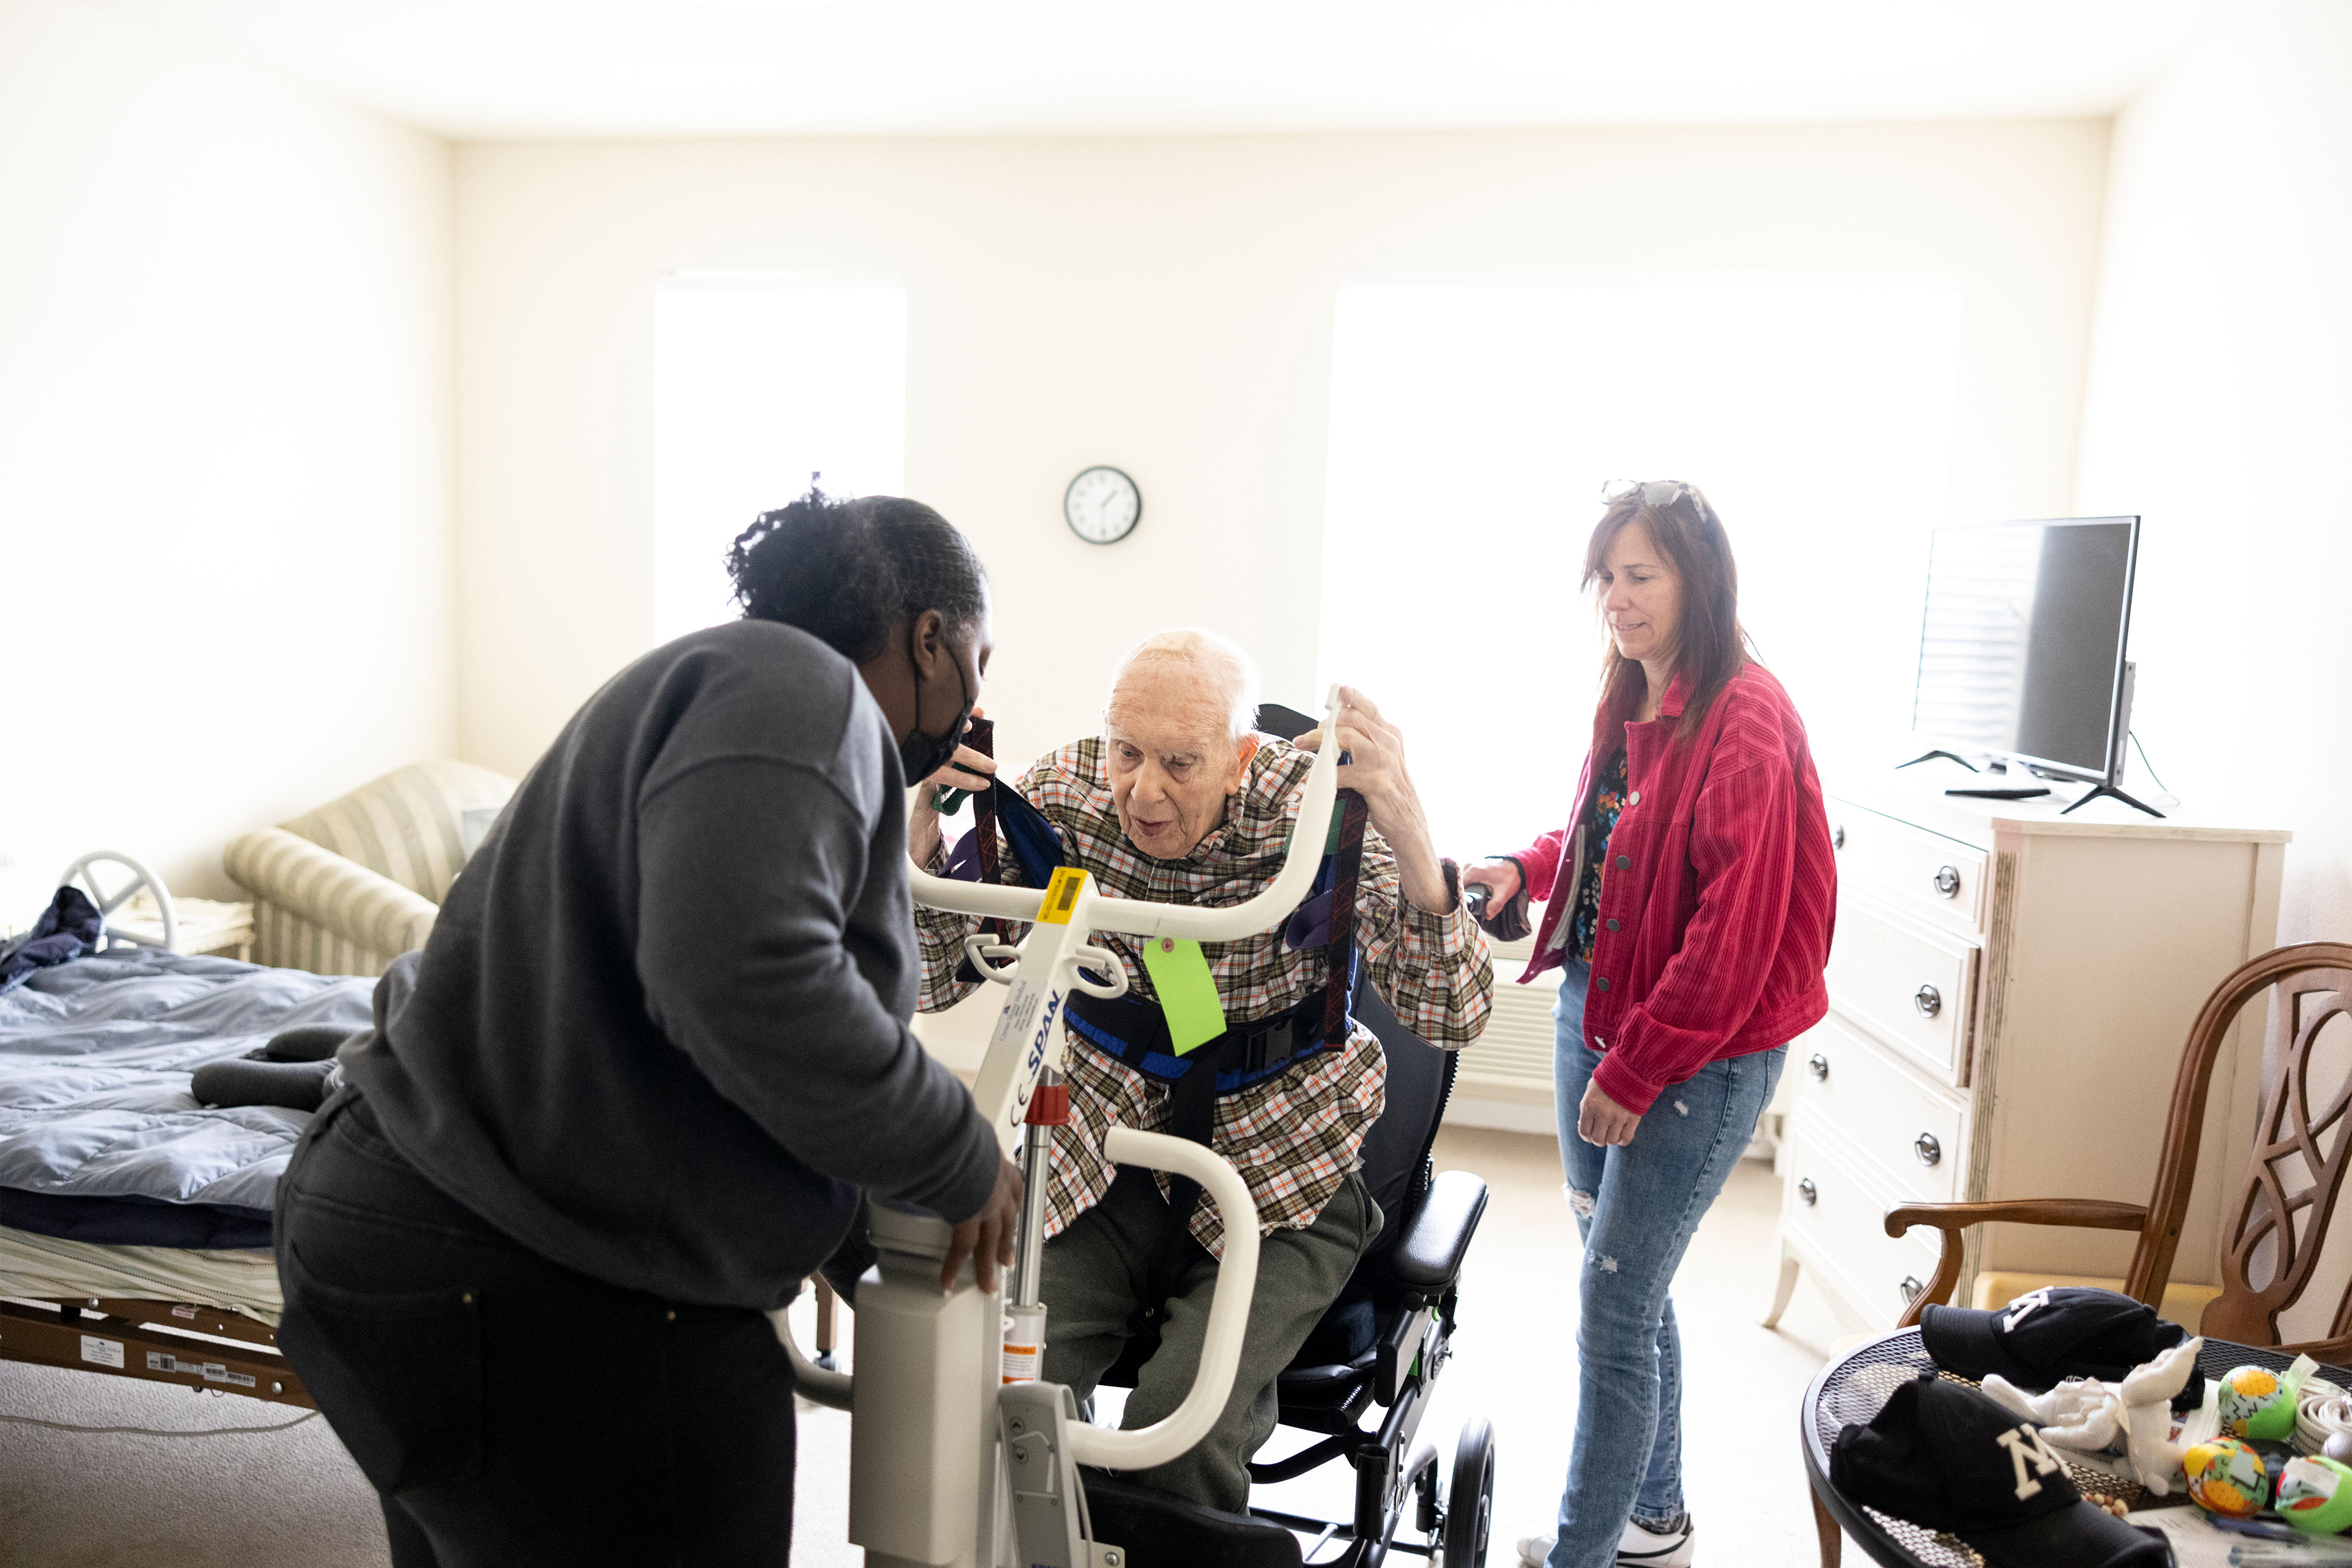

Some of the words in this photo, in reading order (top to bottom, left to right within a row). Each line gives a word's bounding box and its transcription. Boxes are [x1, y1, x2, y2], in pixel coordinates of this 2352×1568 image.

[1028, 989, 1063, 1082] SPAN
[2003, 1286, 2054, 1333] M
[1997, 1423, 2073, 1501] M
